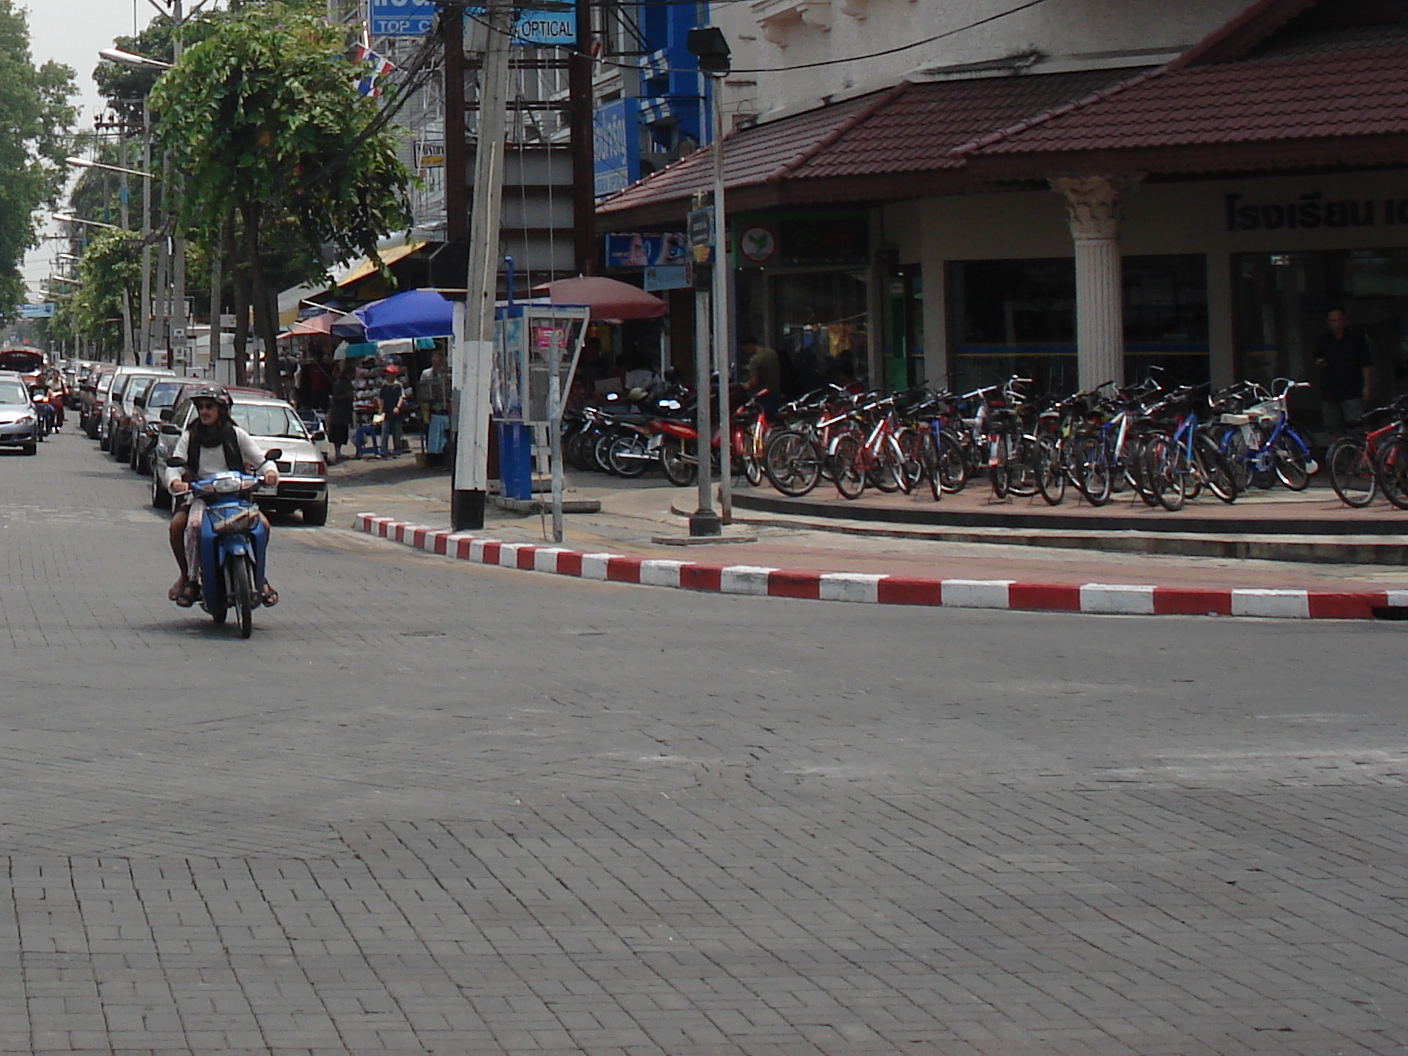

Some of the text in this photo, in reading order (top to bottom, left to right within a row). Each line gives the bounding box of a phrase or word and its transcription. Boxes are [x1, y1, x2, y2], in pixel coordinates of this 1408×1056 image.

[378, 20, 410, 32] TOP
[522, 20, 574, 37] OPTICAL
[1225, 191, 1374, 231] โรงเรียน
